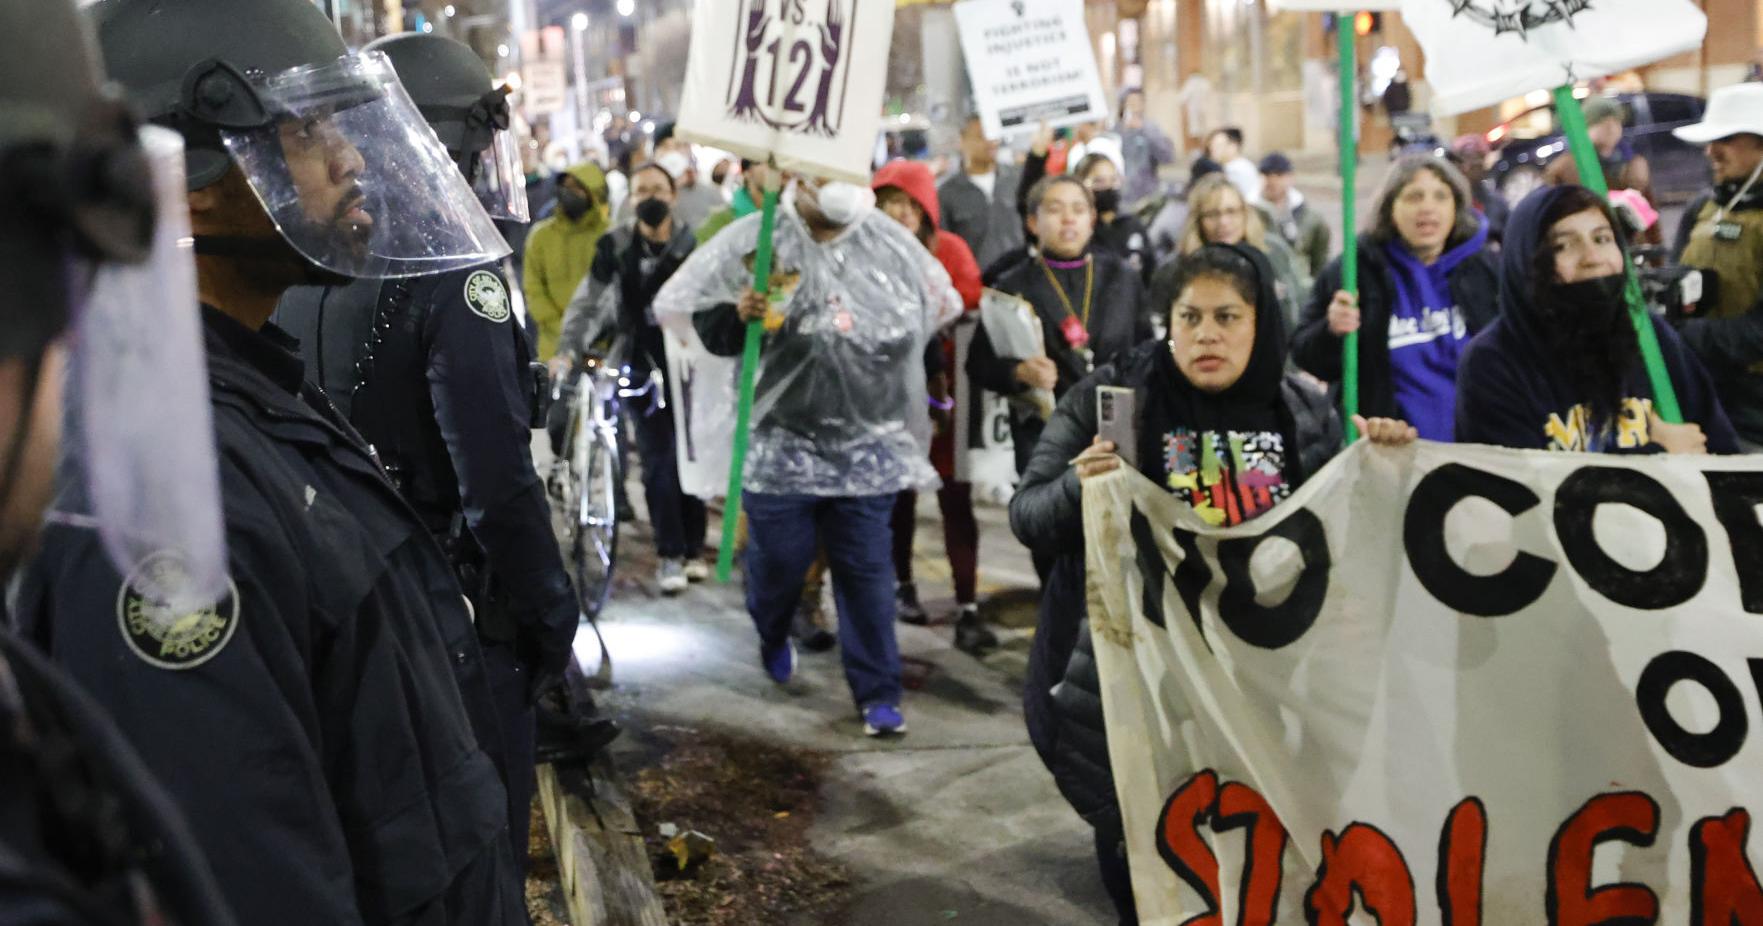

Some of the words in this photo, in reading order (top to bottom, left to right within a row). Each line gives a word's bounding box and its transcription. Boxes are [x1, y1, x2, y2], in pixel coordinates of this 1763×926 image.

[984, 15, 1063, 39] FIGHTING
[987, 31, 1067, 54] INJUSTICE
[766, 37, 813, 112] 12
[1130, 503, 1331, 650] NO
[160, 613, 227, 657] POLICE
[1636, 650, 1763, 769] O
